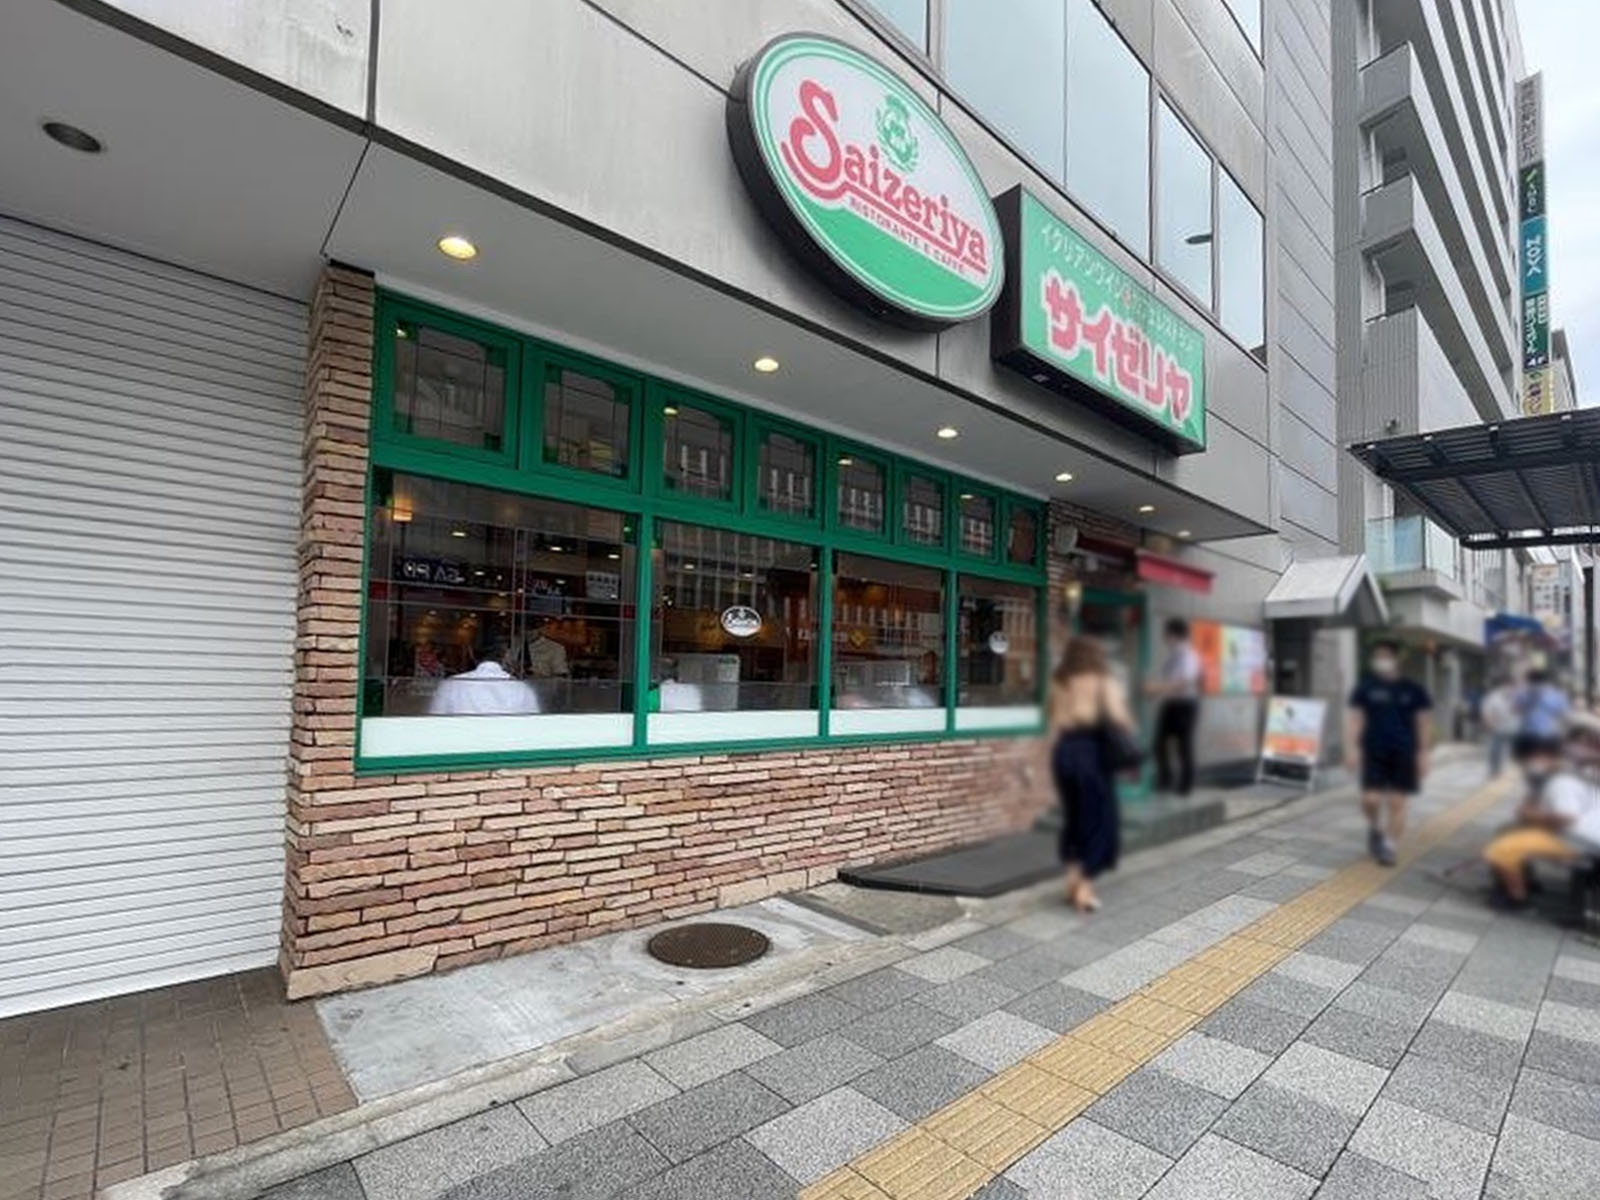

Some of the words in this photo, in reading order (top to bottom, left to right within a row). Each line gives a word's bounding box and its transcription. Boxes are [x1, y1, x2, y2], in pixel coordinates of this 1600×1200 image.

[781, 80, 988, 269] Saizeriya
[1044, 275, 1192, 424] サイゼリヤ
